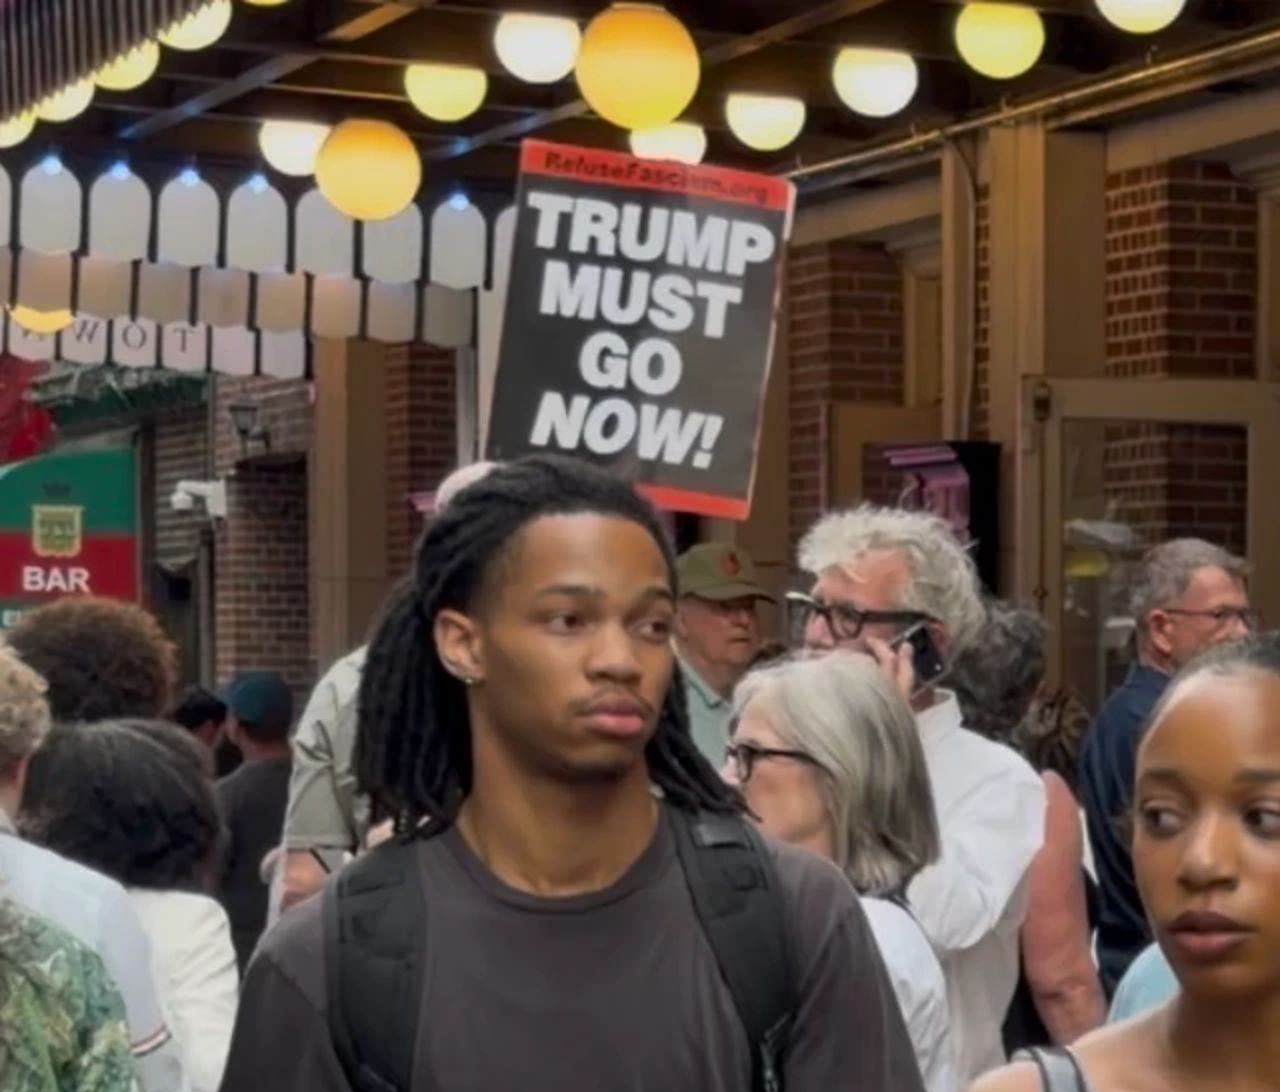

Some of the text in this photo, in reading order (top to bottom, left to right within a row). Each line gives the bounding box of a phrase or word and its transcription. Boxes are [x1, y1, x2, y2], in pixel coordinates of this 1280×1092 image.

[526, 191, 776, 276] TRUMP
[538, 259, 743, 339] MUST
[578, 331, 683, 396] GO
[529, 391, 724, 470] NOW!
[23, 565, 91, 593] BAR
